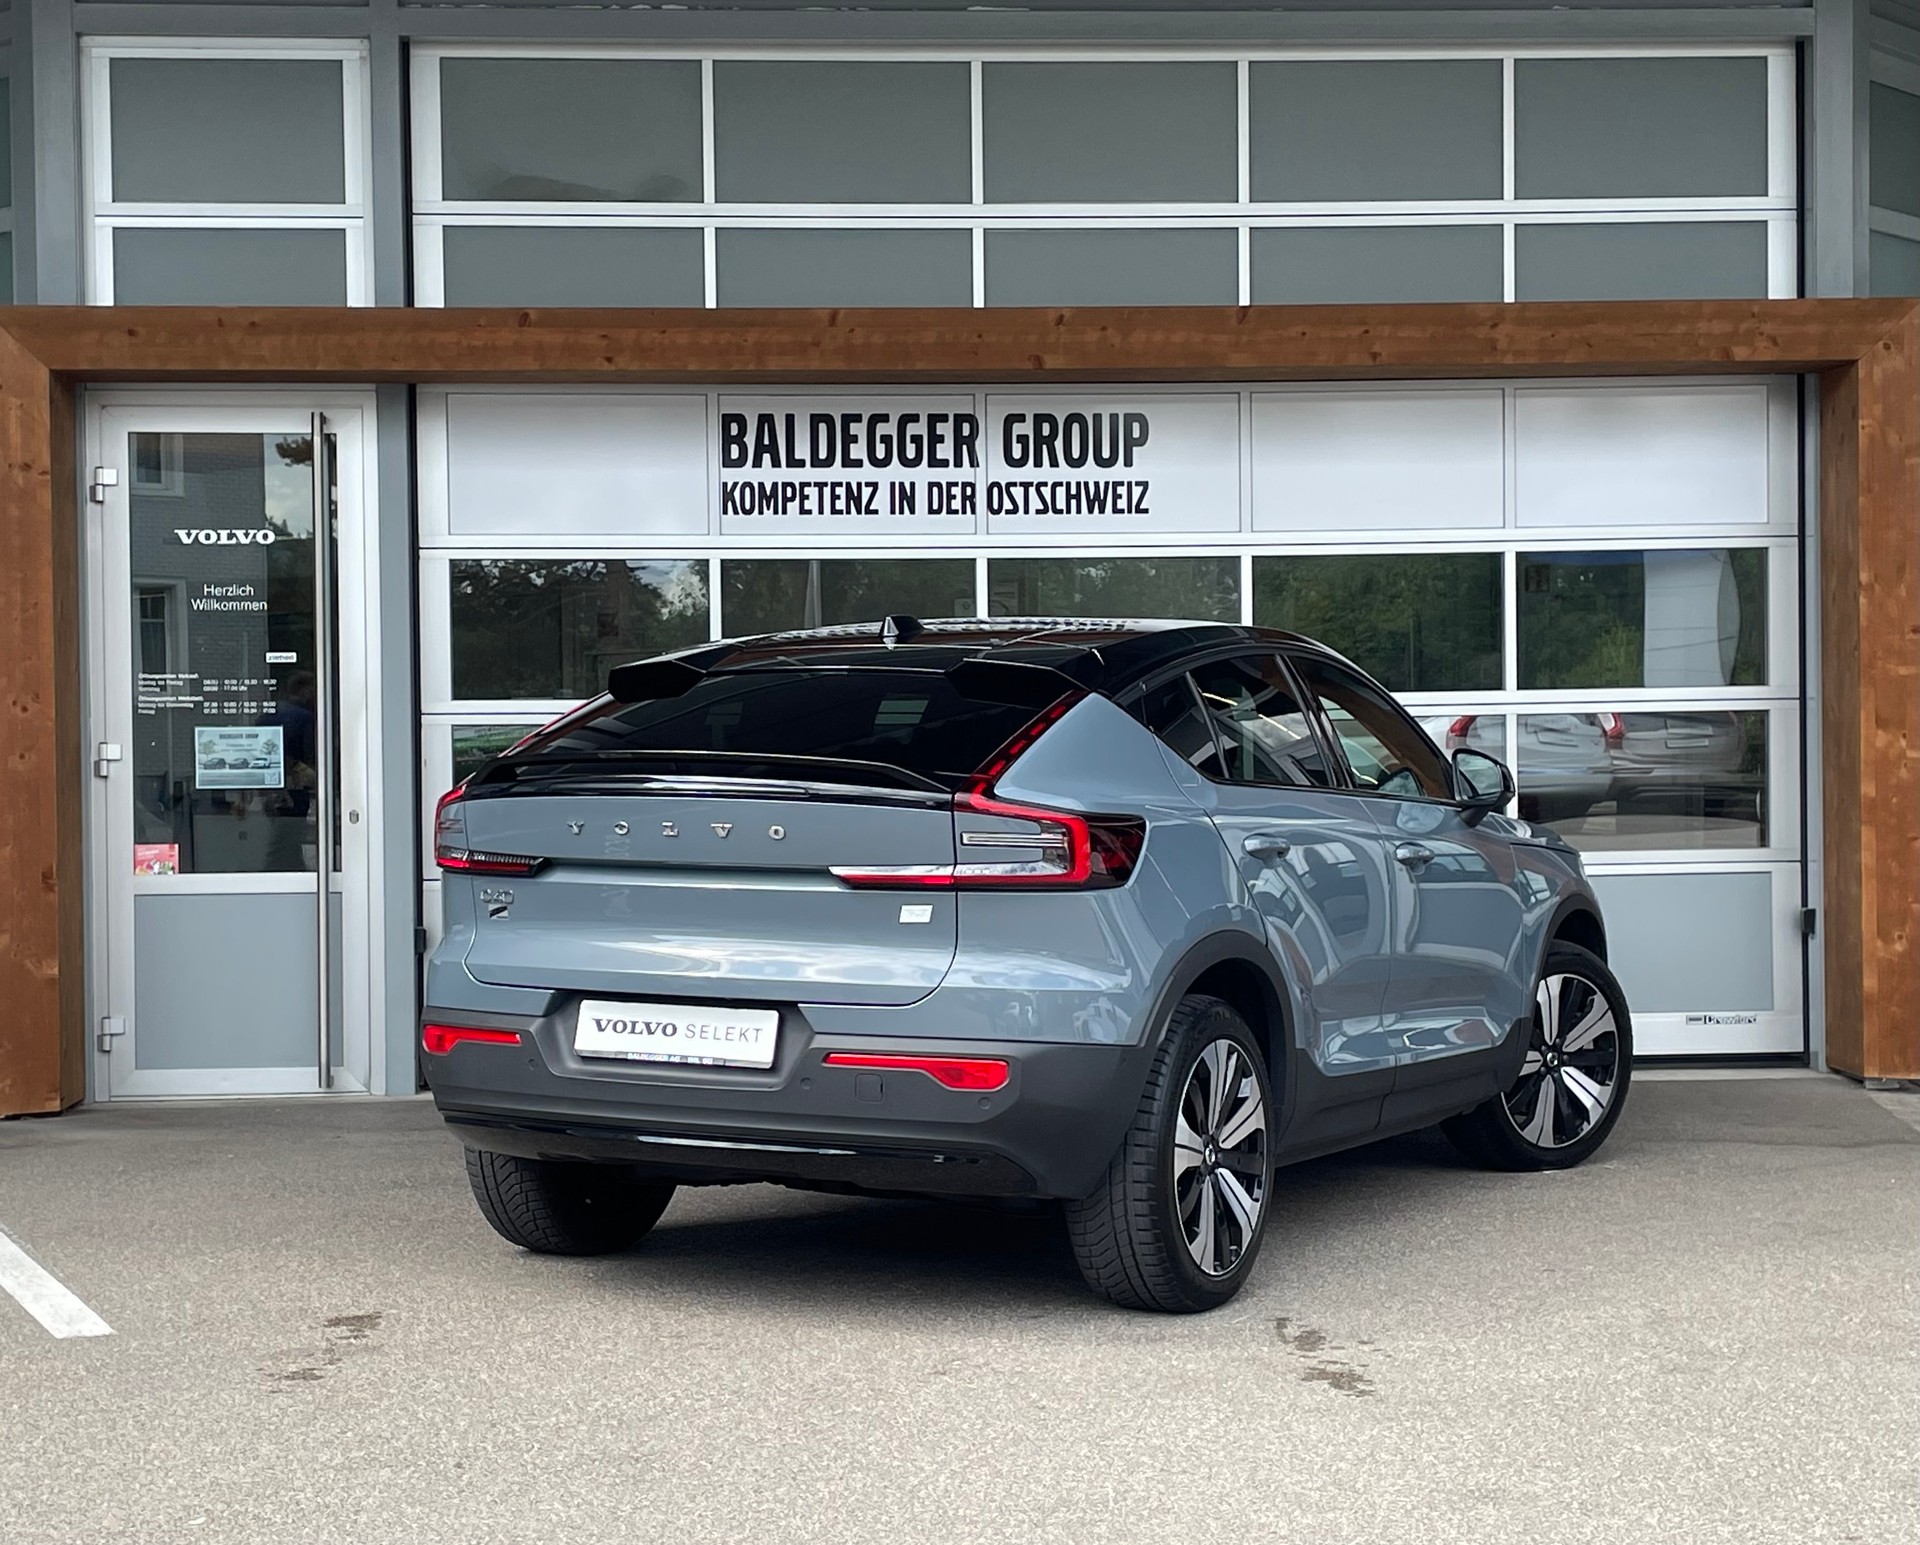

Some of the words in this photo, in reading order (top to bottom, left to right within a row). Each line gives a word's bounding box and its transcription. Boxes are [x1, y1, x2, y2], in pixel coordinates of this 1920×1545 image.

[720, 412, 980, 469] BALDEGGER
[1003, 412, 1149, 469] GROUP
[721, 481, 879, 515] KOMPETENZ
[889, 481, 916, 515] IN
[927, 481, 976, 515] DER
[987, 480, 1150, 515] OSTSCHWEIZ
[174, 529, 276, 545] VOLVO
[203, 583, 254, 596] Herzlich
[191, 598, 268, 611] Willkommen
[566, 820, 785, 840] VOLVO
[592, 1018, 678, 1037] VOLVO
[685, 1023, 763, 1043] SELEKT
